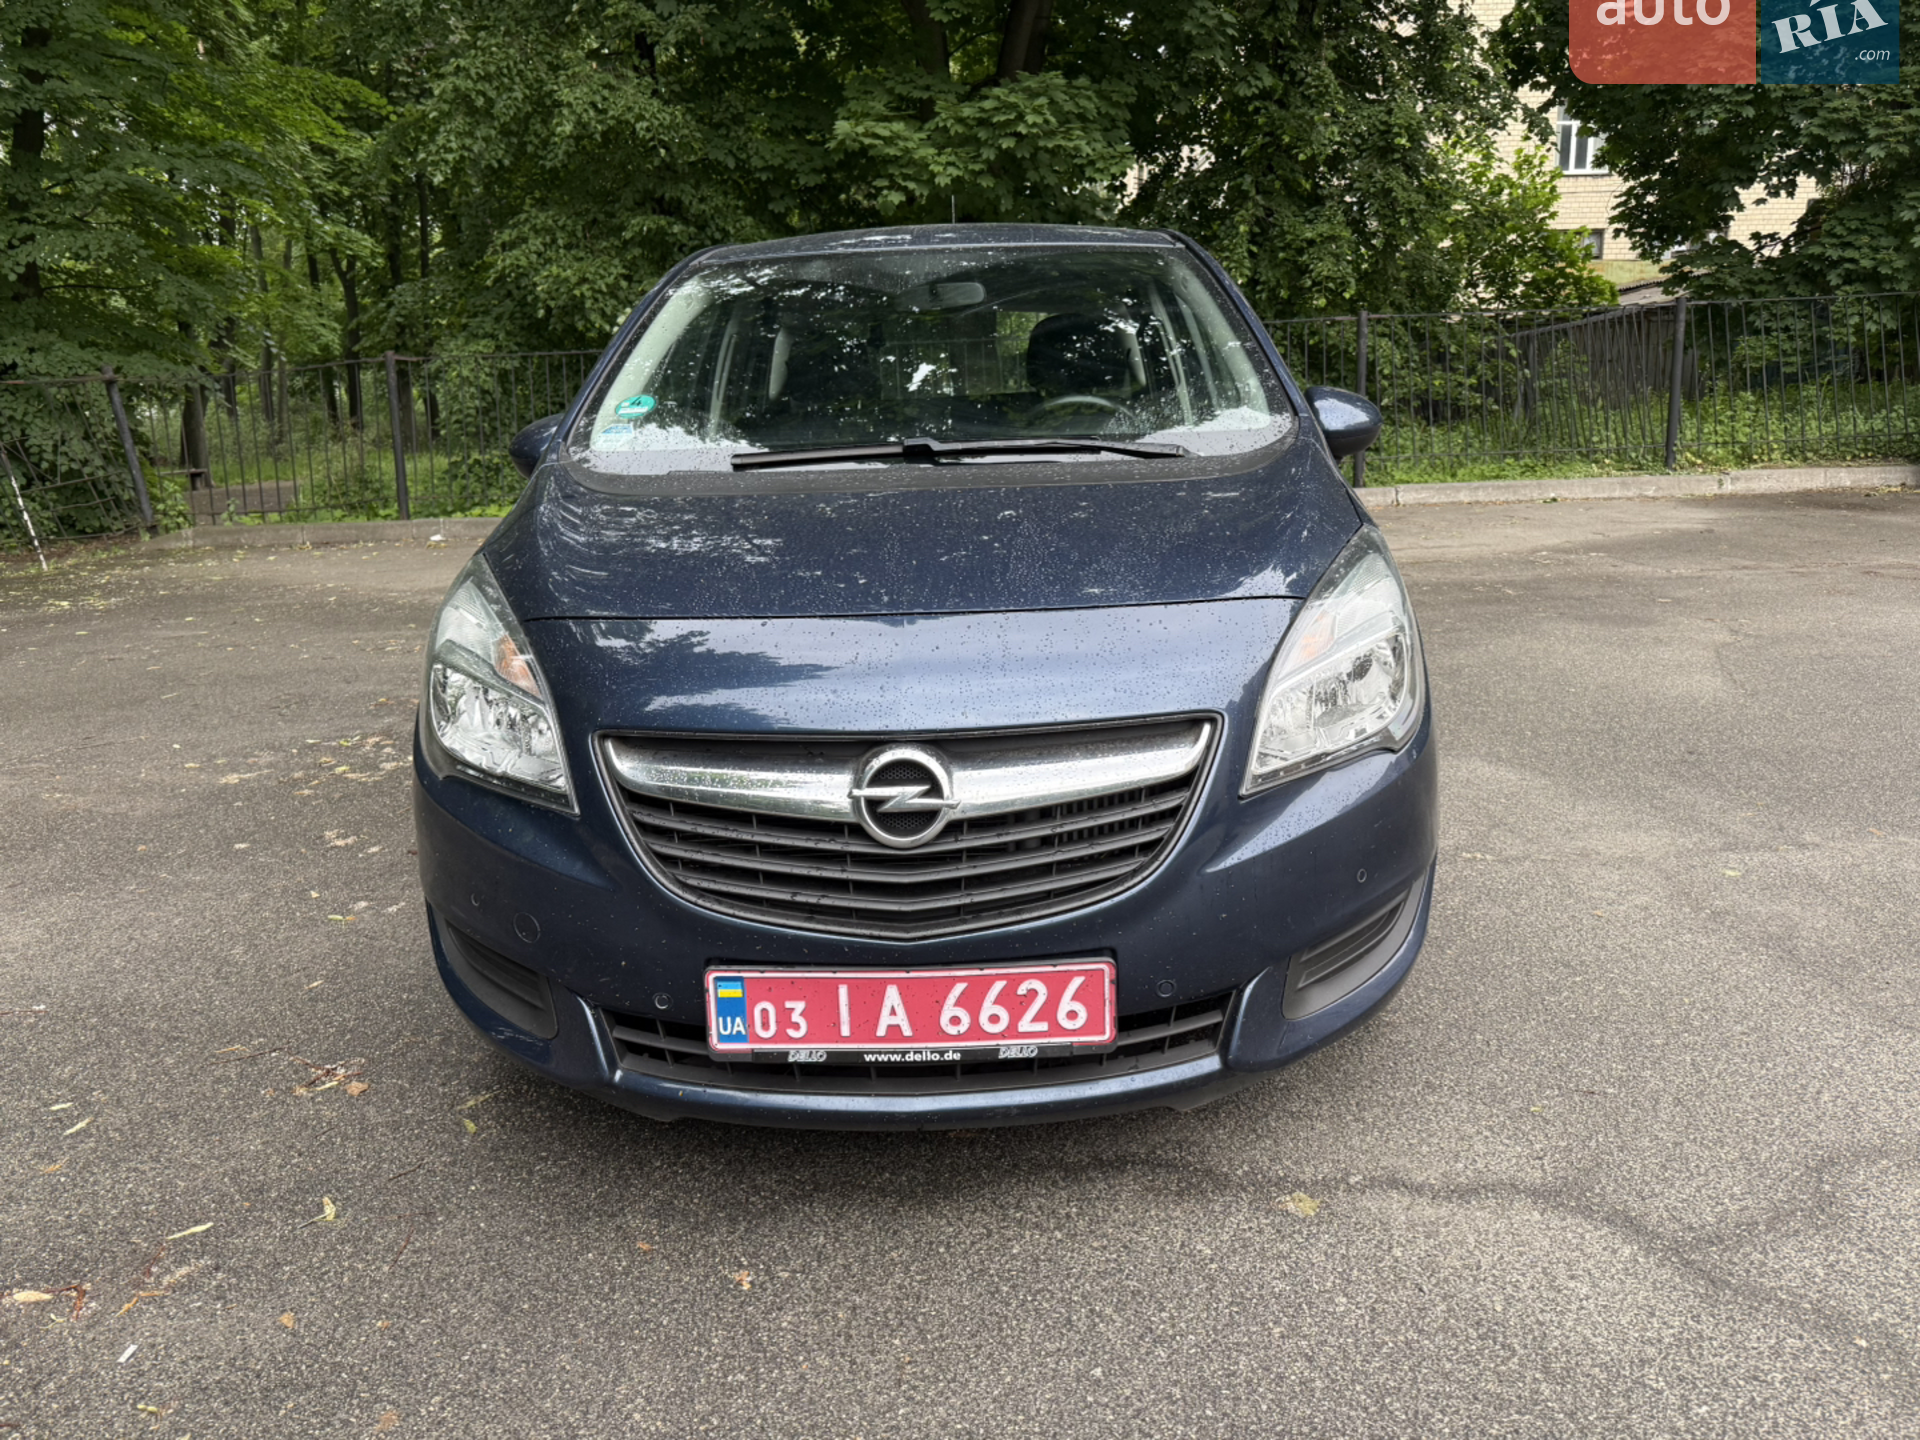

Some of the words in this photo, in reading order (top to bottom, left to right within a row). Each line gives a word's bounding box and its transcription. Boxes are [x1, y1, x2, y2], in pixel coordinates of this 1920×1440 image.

[718, 1016, 747, 1035] UA
[753, 1000, 809, 1039] 03
[939, 975, 1089, 1036] 6626
[787, 1050, 828, 1063] DELLO
[863, 1049, 962, 1062] www.dello.de
[998, 1045, 1039, 1060] DELLO
